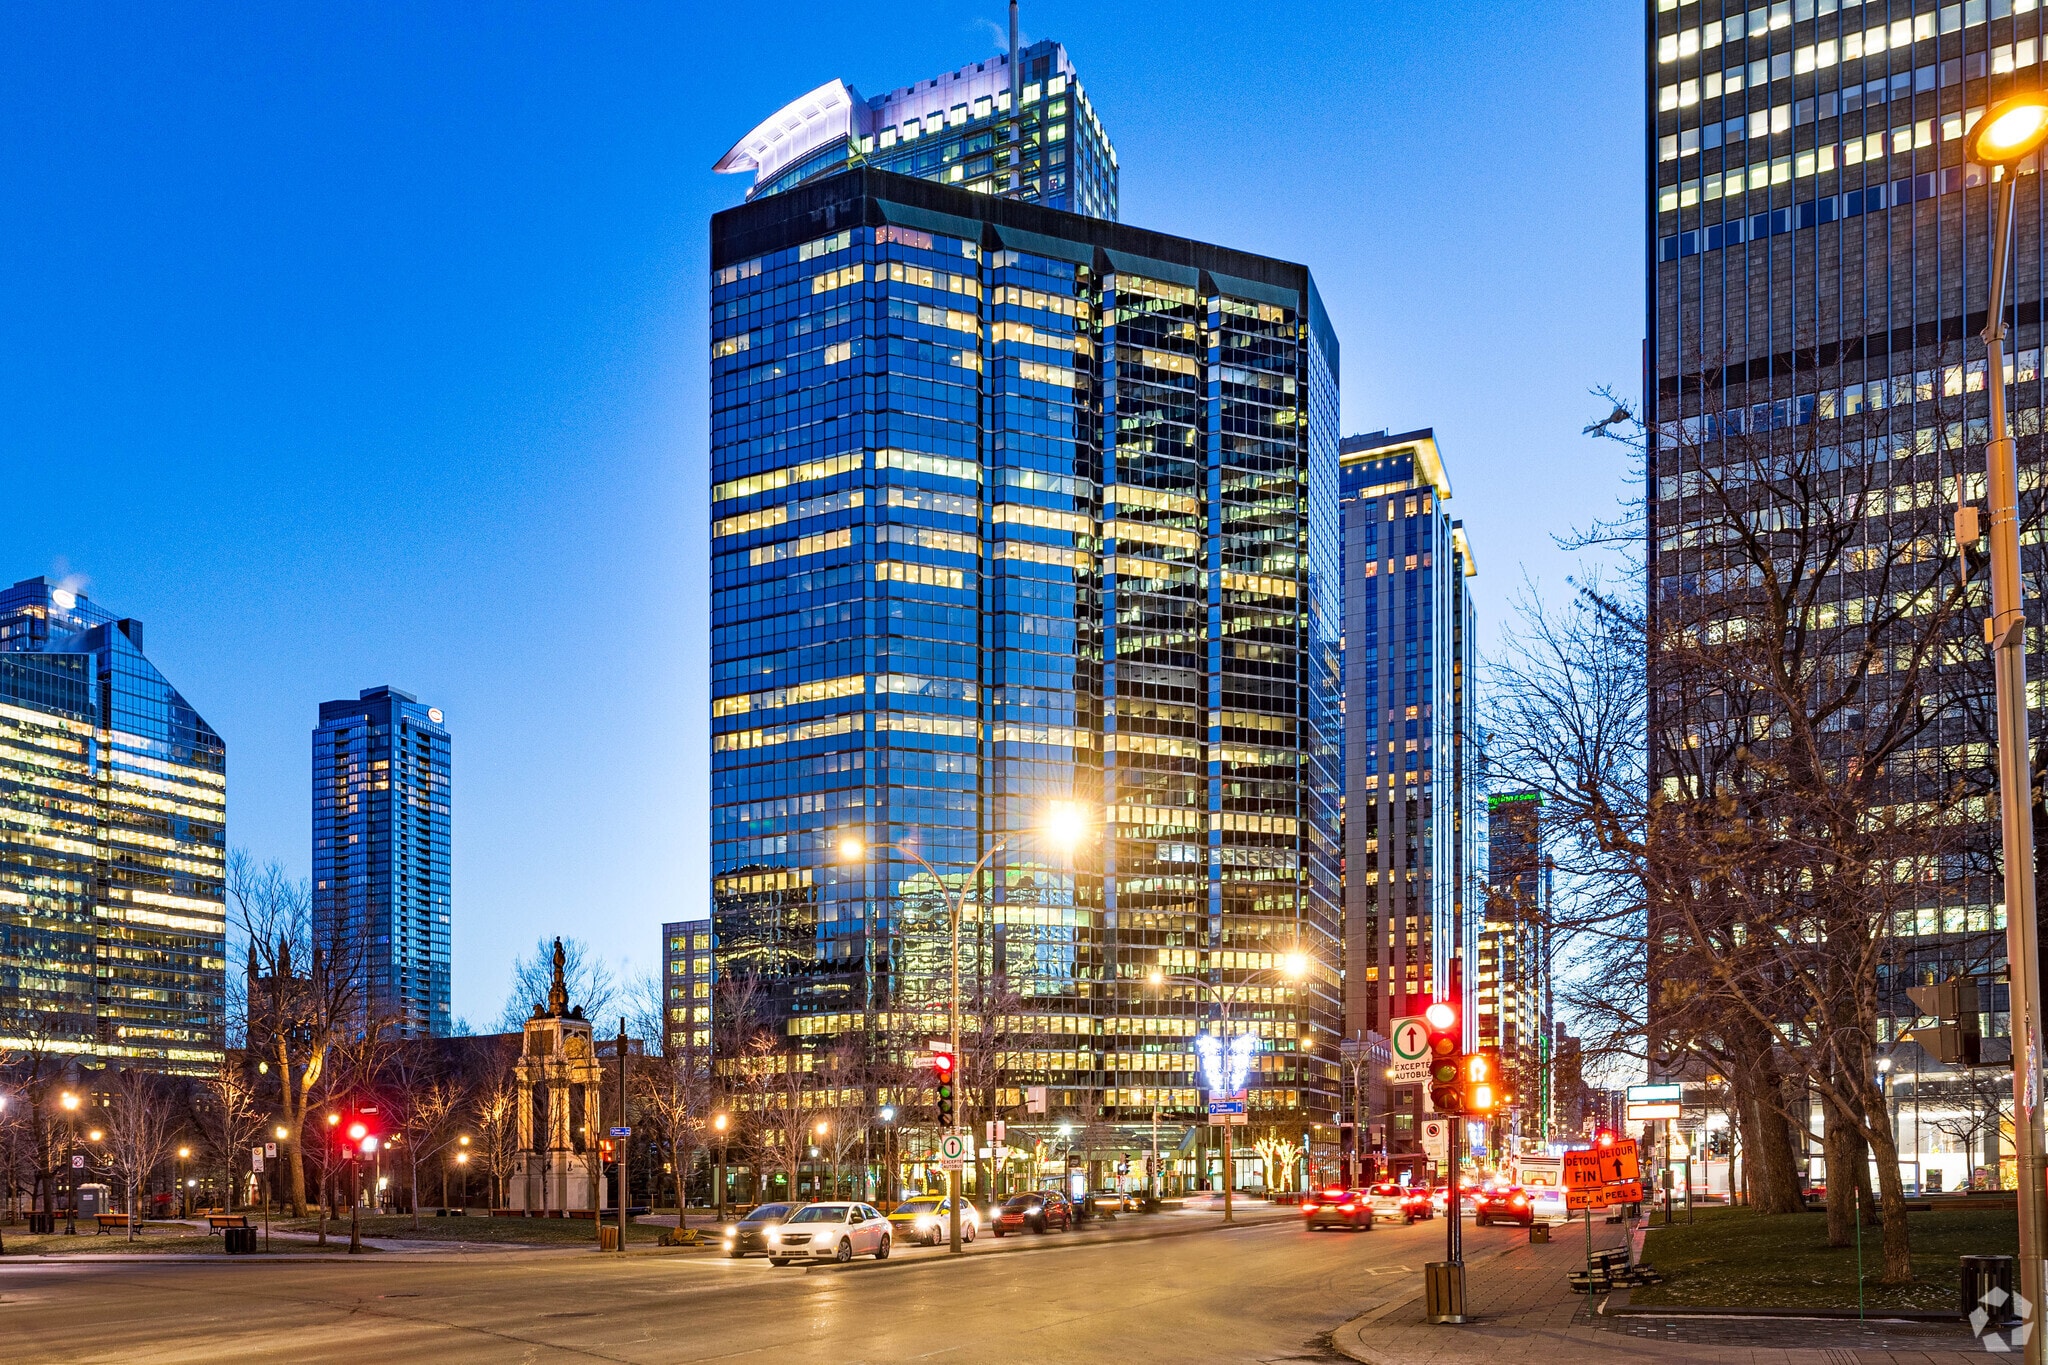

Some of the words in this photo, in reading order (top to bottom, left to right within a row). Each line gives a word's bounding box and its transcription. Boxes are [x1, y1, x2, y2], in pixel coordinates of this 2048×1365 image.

[1394, 1070, 1432, 1080] AUTOBUS
[1575, 1171, 1596, 1183] FIN
[1605, 1191, 1628, 1199] PEEL
